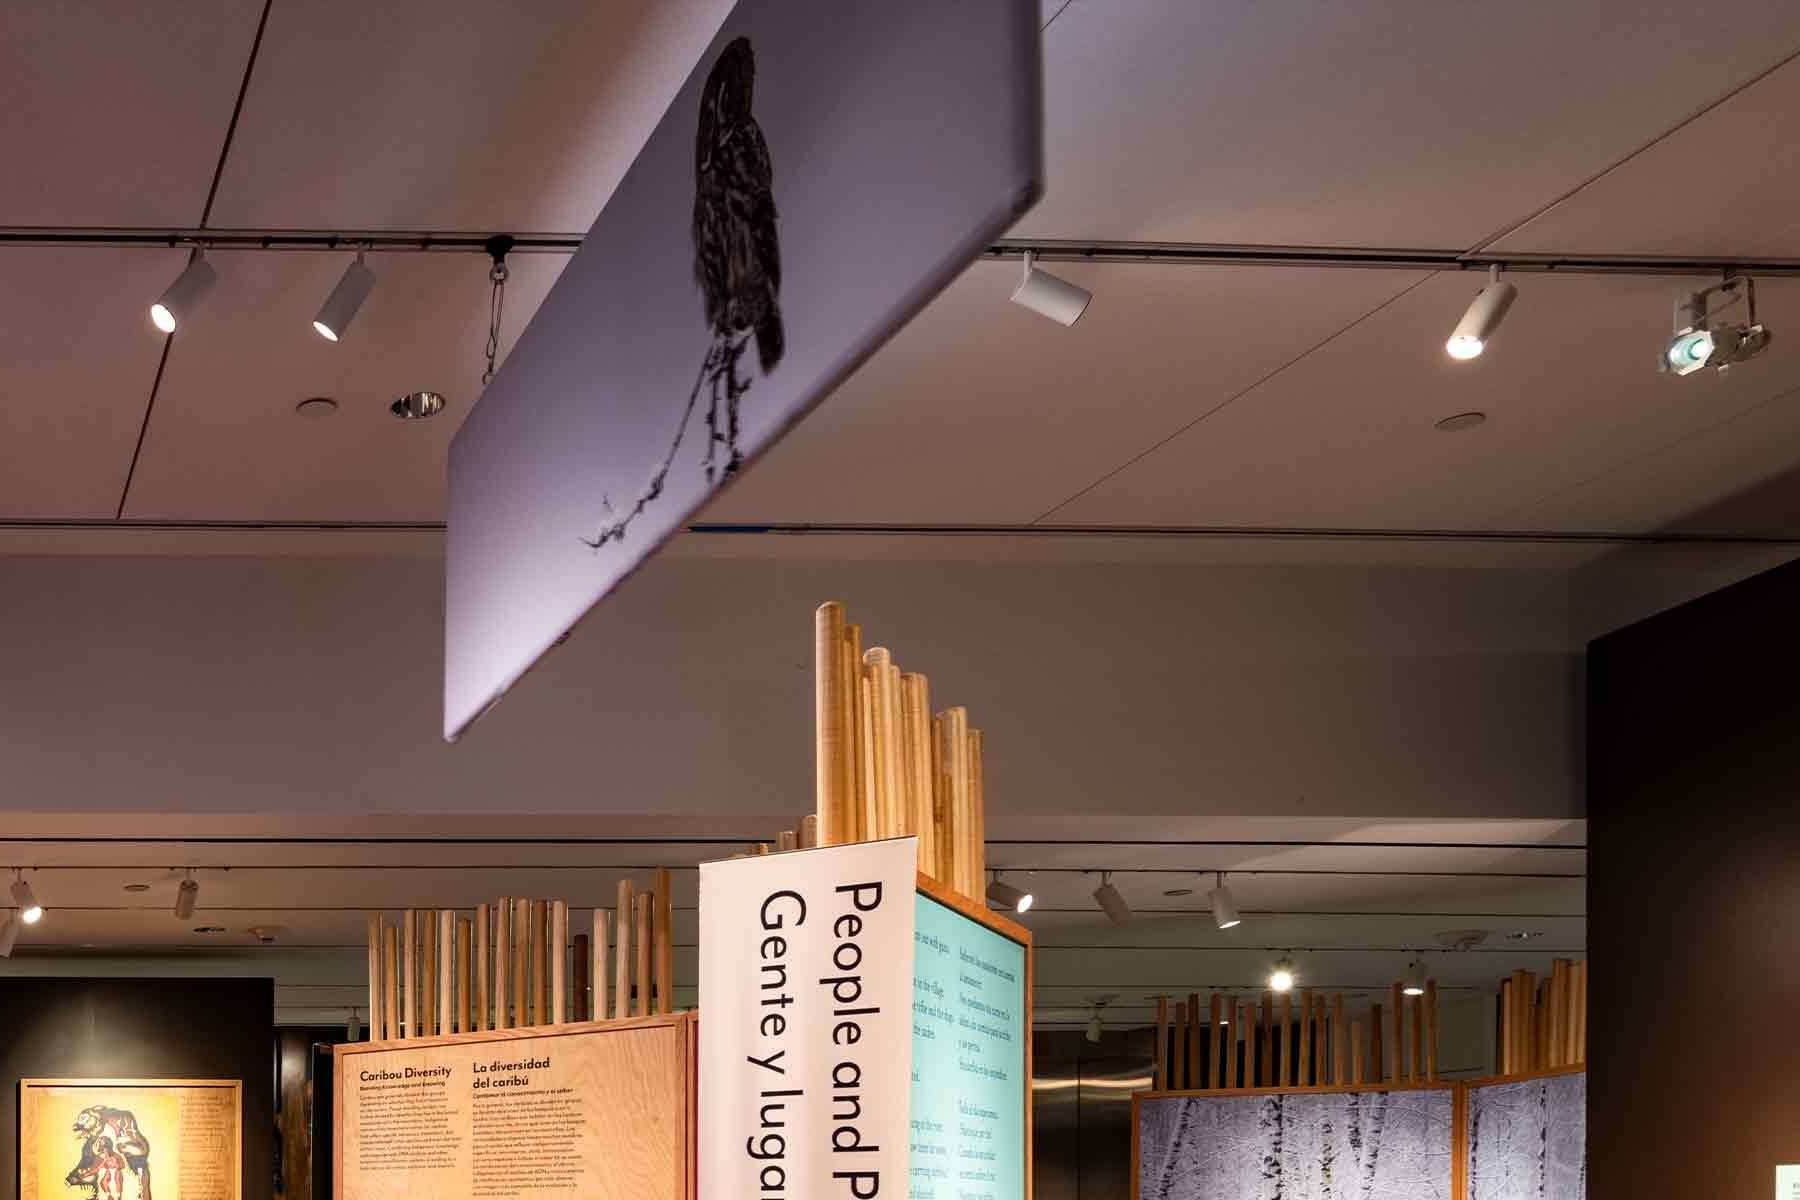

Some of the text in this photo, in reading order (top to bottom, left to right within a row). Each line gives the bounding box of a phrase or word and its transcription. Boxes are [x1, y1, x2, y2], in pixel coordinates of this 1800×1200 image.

[760, 890, 807, 1037] Gente
[819, 881, 882, 1046] People
[360, 1067, 452, 1081] Caribou Diversity
[473, 1057, 550, 1073] La diversidad
[747, 1049, 785, 1075] y
[473, 1074, 529, 1089] del caribú
[831, 1060, 880, 1152] and
